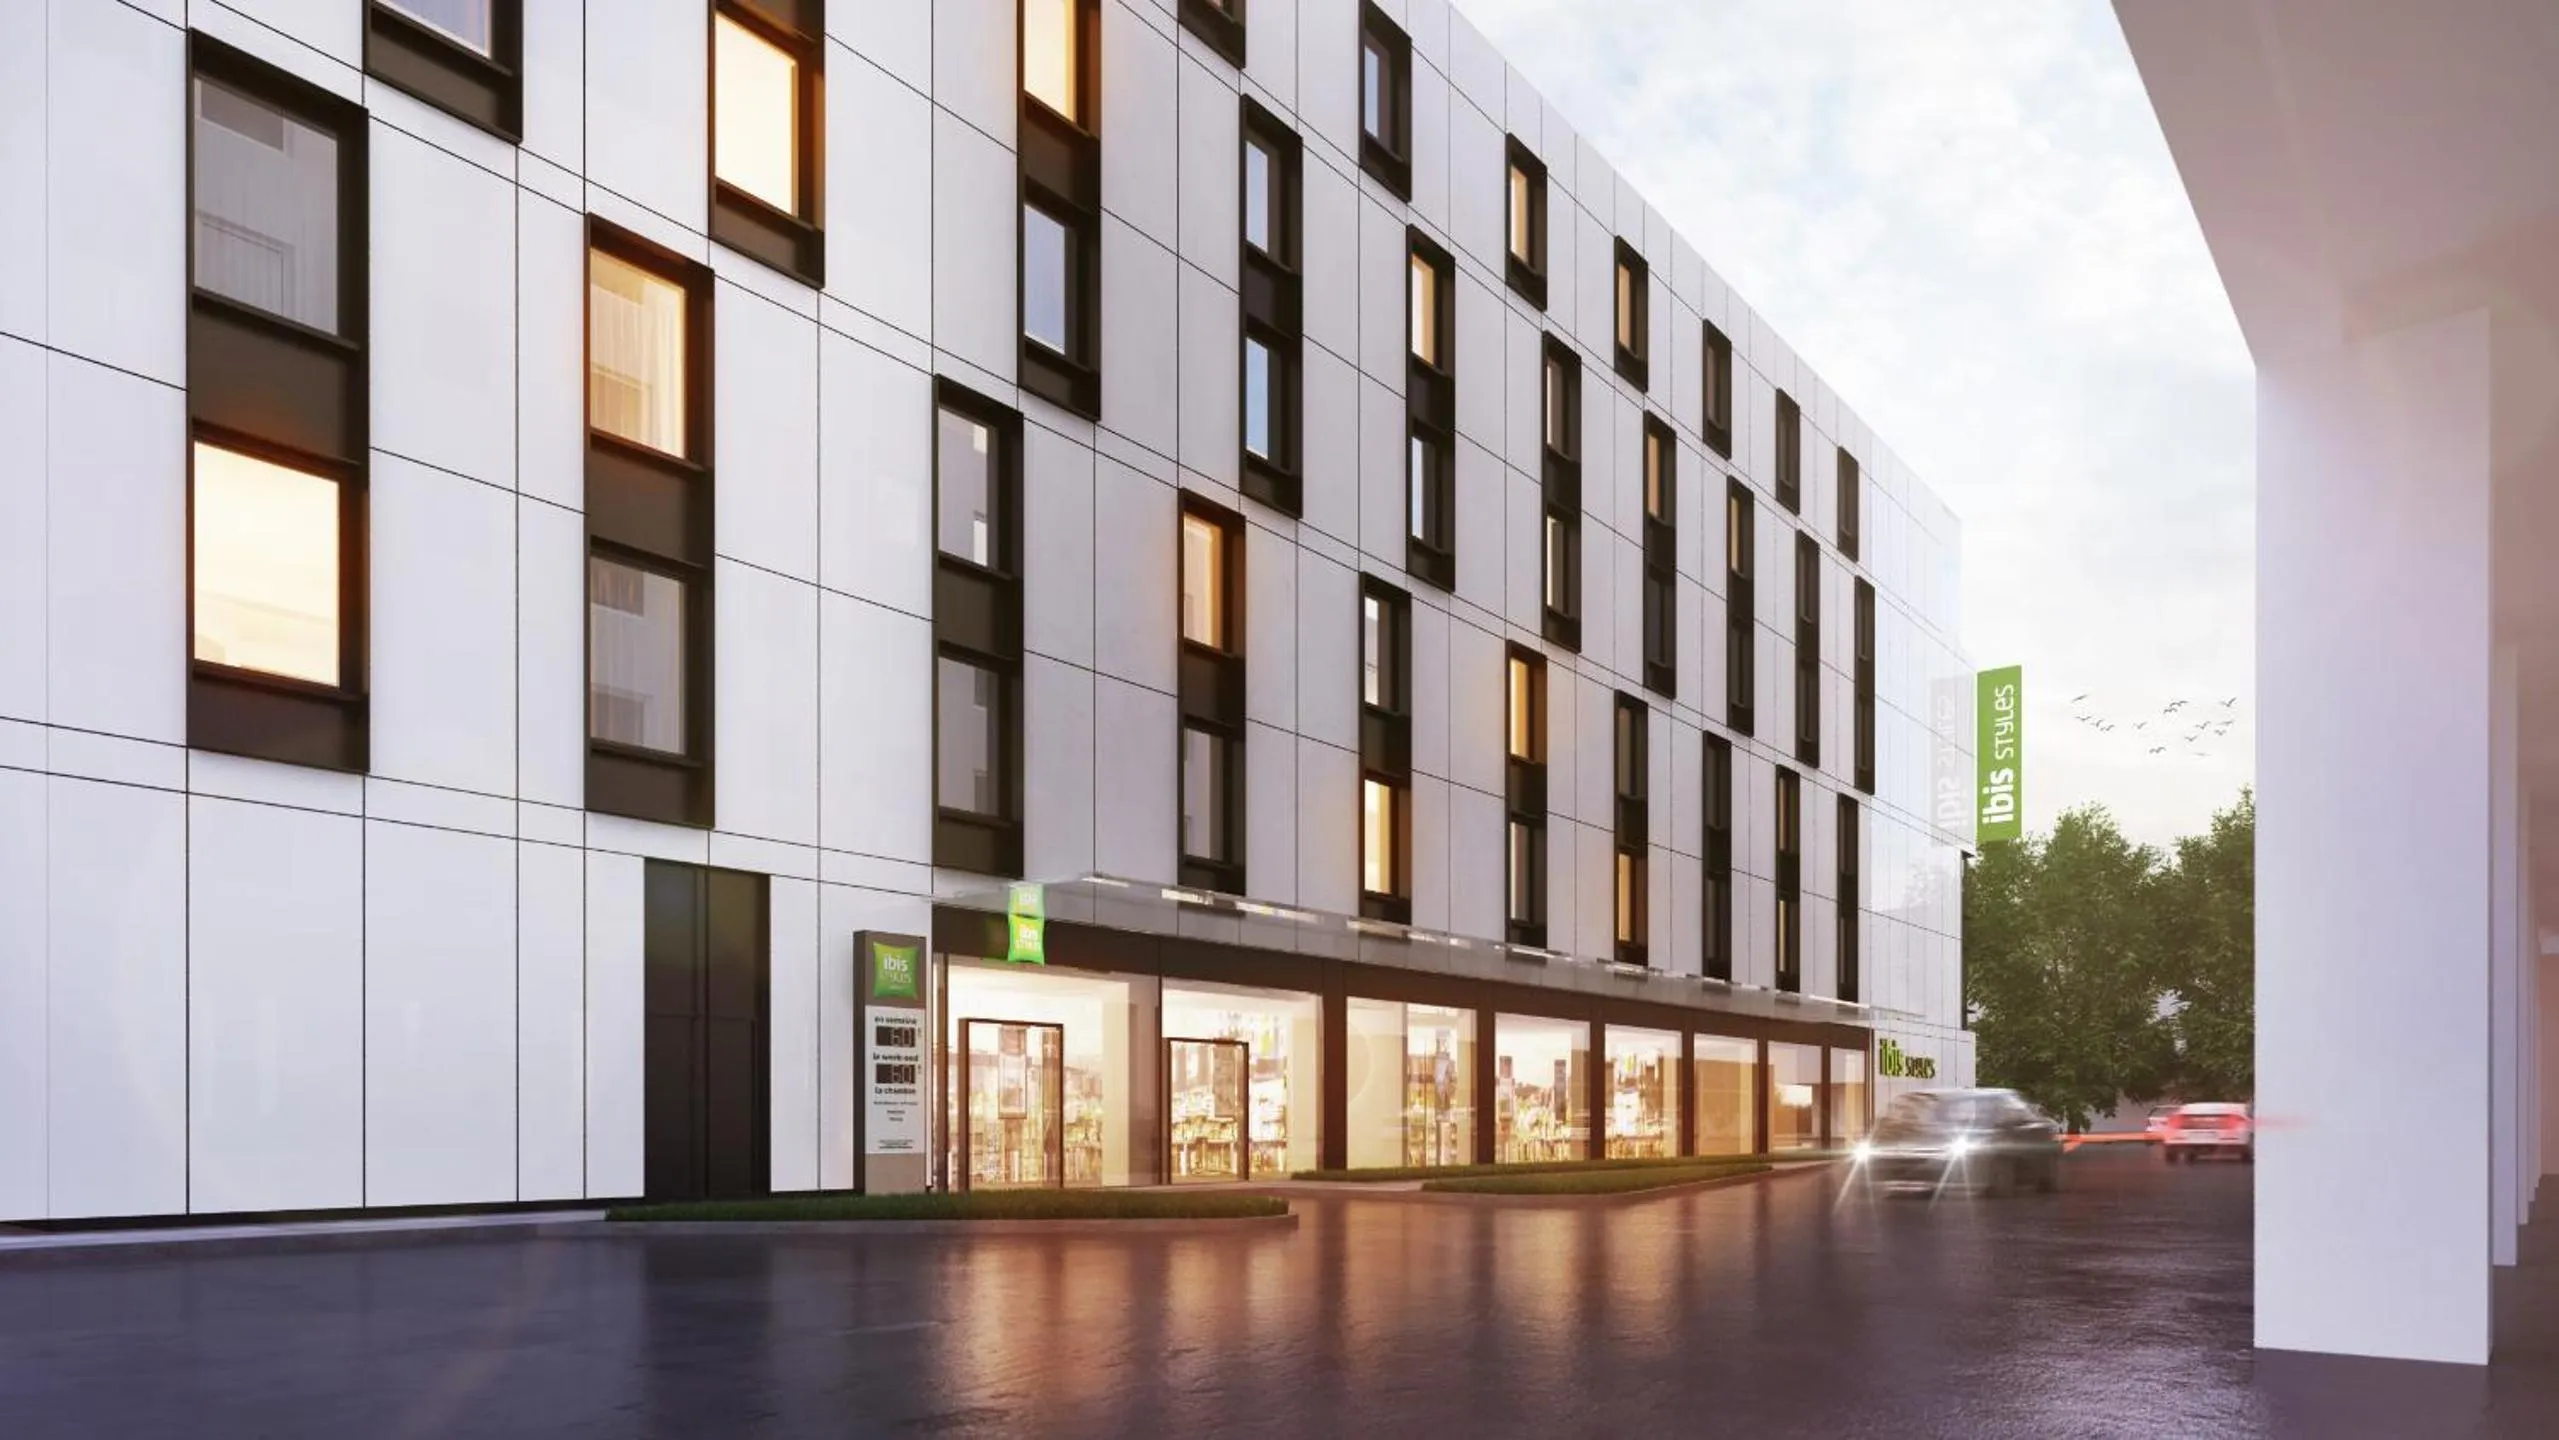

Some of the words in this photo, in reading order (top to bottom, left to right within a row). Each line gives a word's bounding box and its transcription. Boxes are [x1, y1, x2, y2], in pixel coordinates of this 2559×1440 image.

[1982, 767, 2014, 824] ibis
[883, 953, 908, 972] ibis
[1879, 1038, 1903, 1077] ibis
